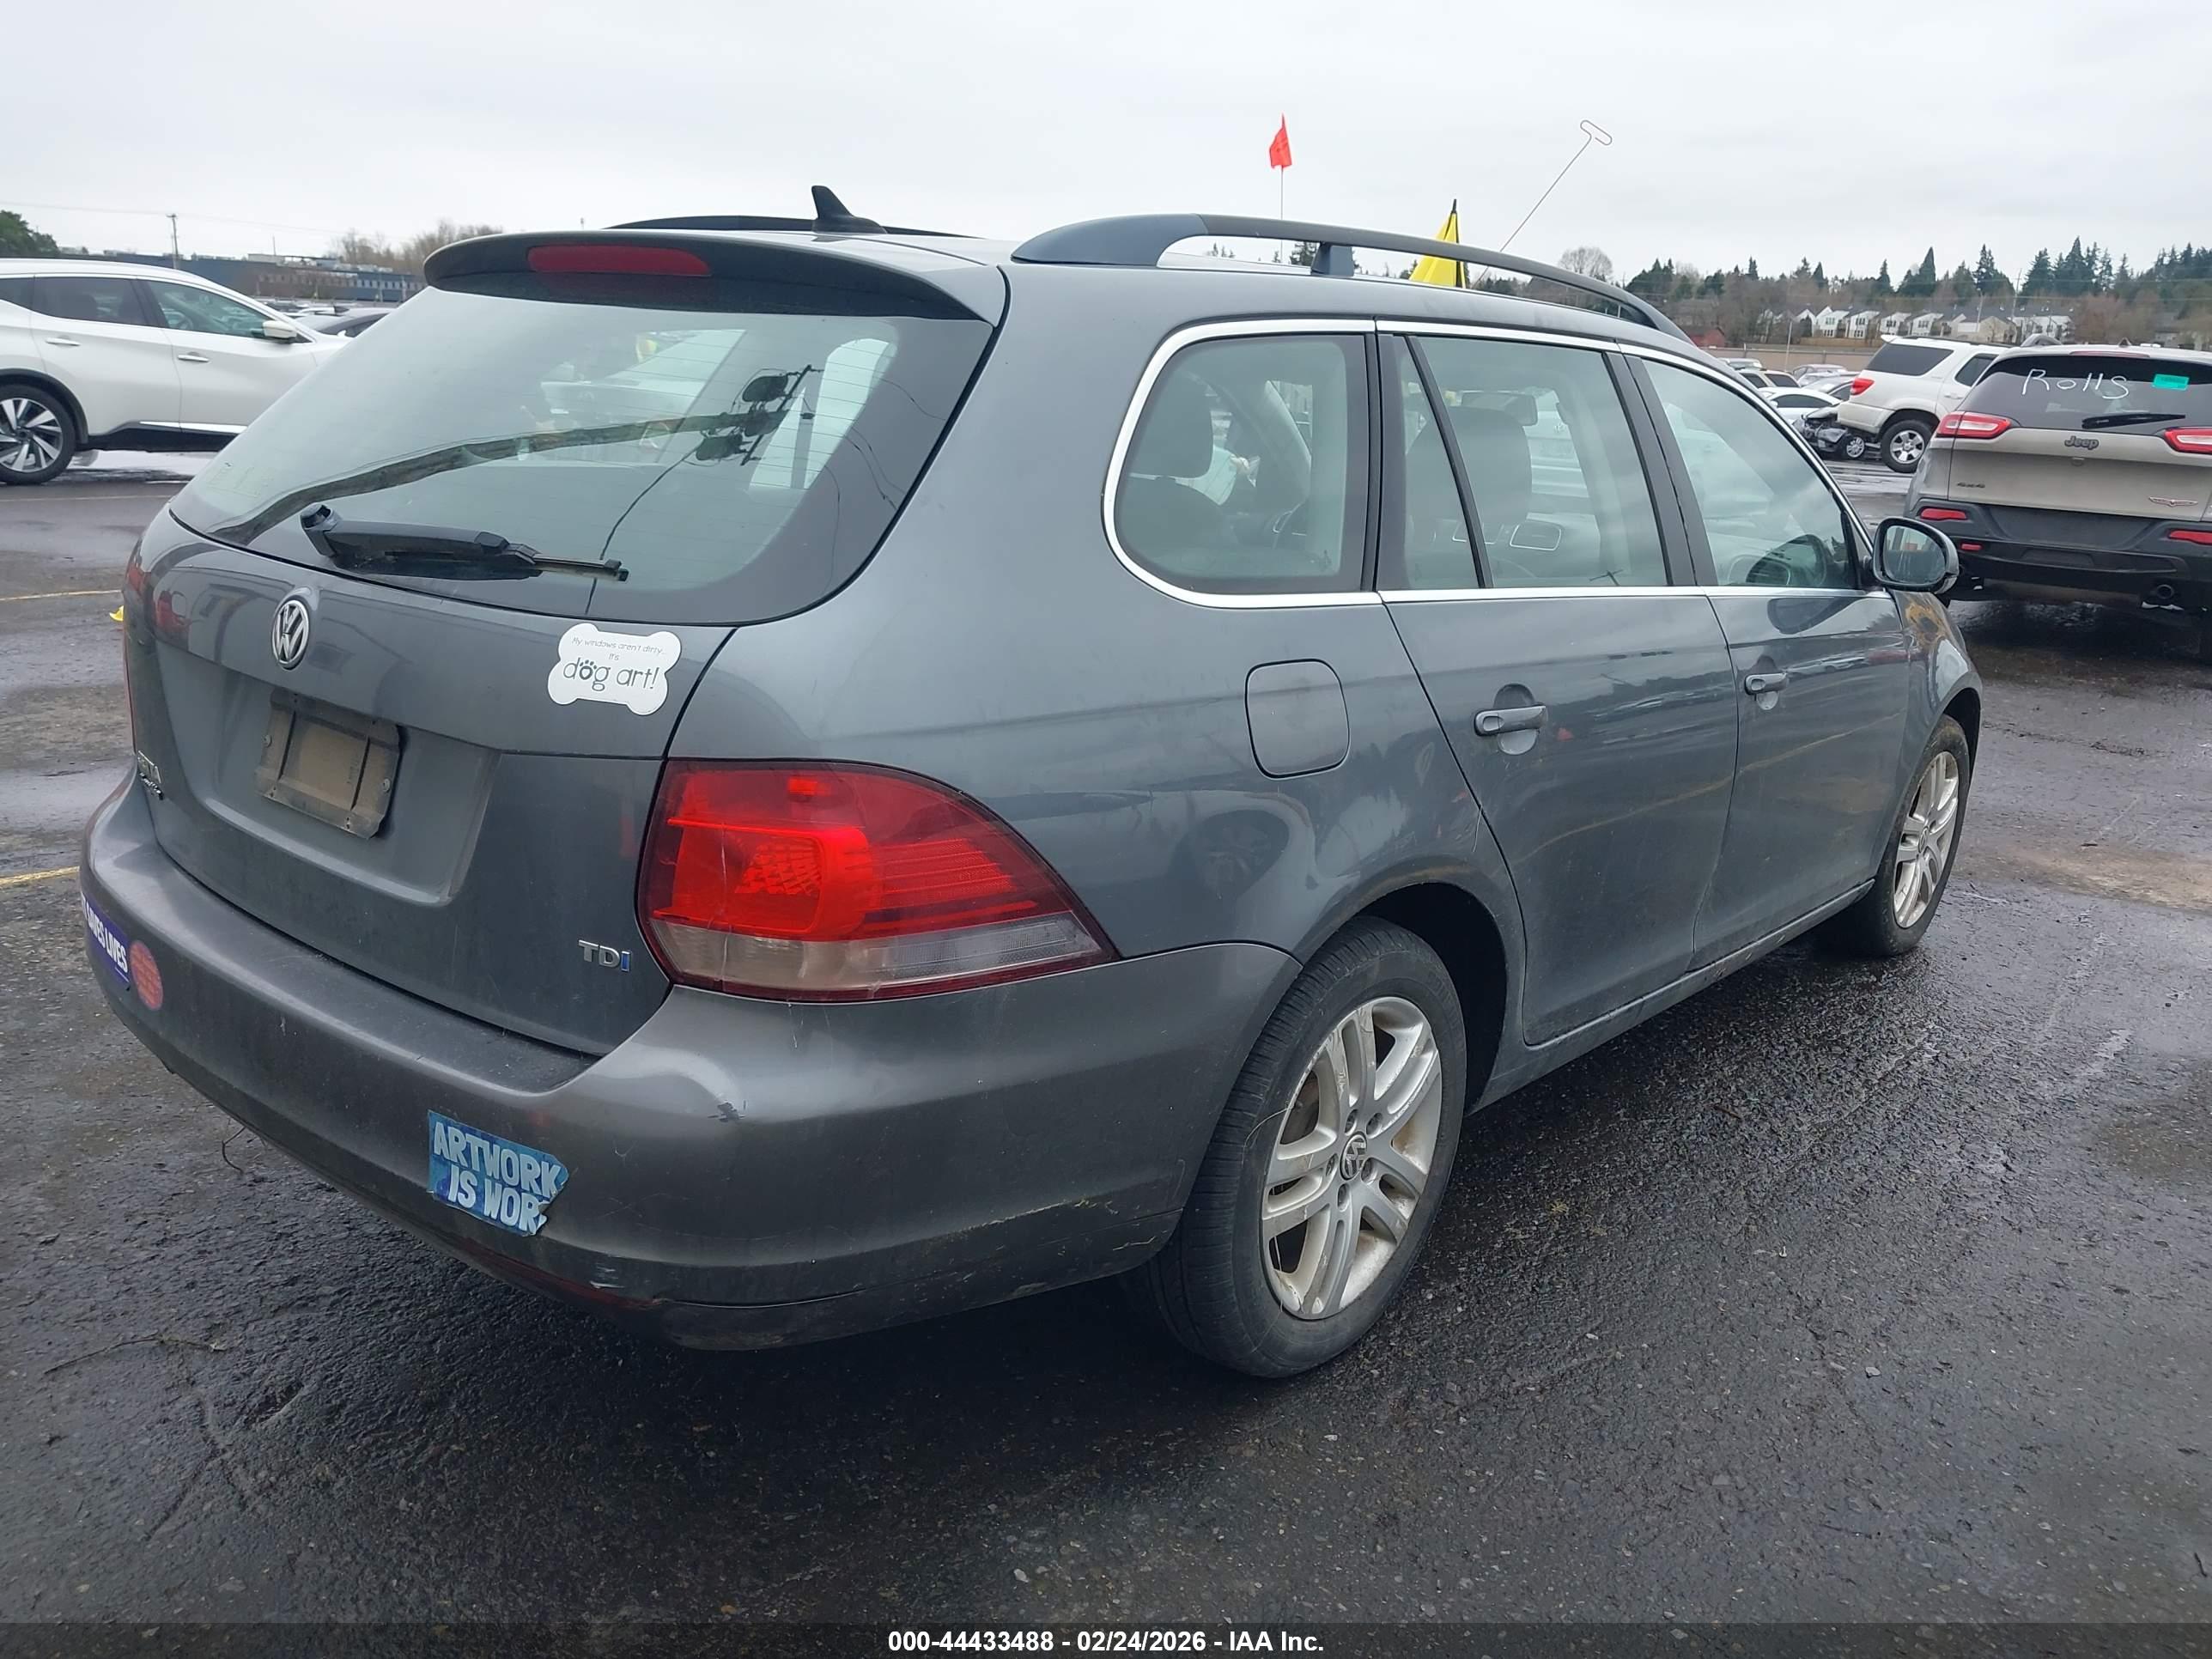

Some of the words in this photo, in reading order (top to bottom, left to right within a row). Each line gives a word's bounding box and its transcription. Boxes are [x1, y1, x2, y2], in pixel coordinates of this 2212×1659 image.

[2064, 435, 2099, 450] Jeep
[585, 639, 617, 649] windows
[618, 642, 641, 653] aren't
[563, 657, 611, 691] dog
[617, 666, 659, 690] art!
[104, 927, 128, 973] LIVES
[578, 939, 631, 972] TDI
[434, 1121, 561, 1199] ARTWORK
[447, 1164, 478, 1208] IS
